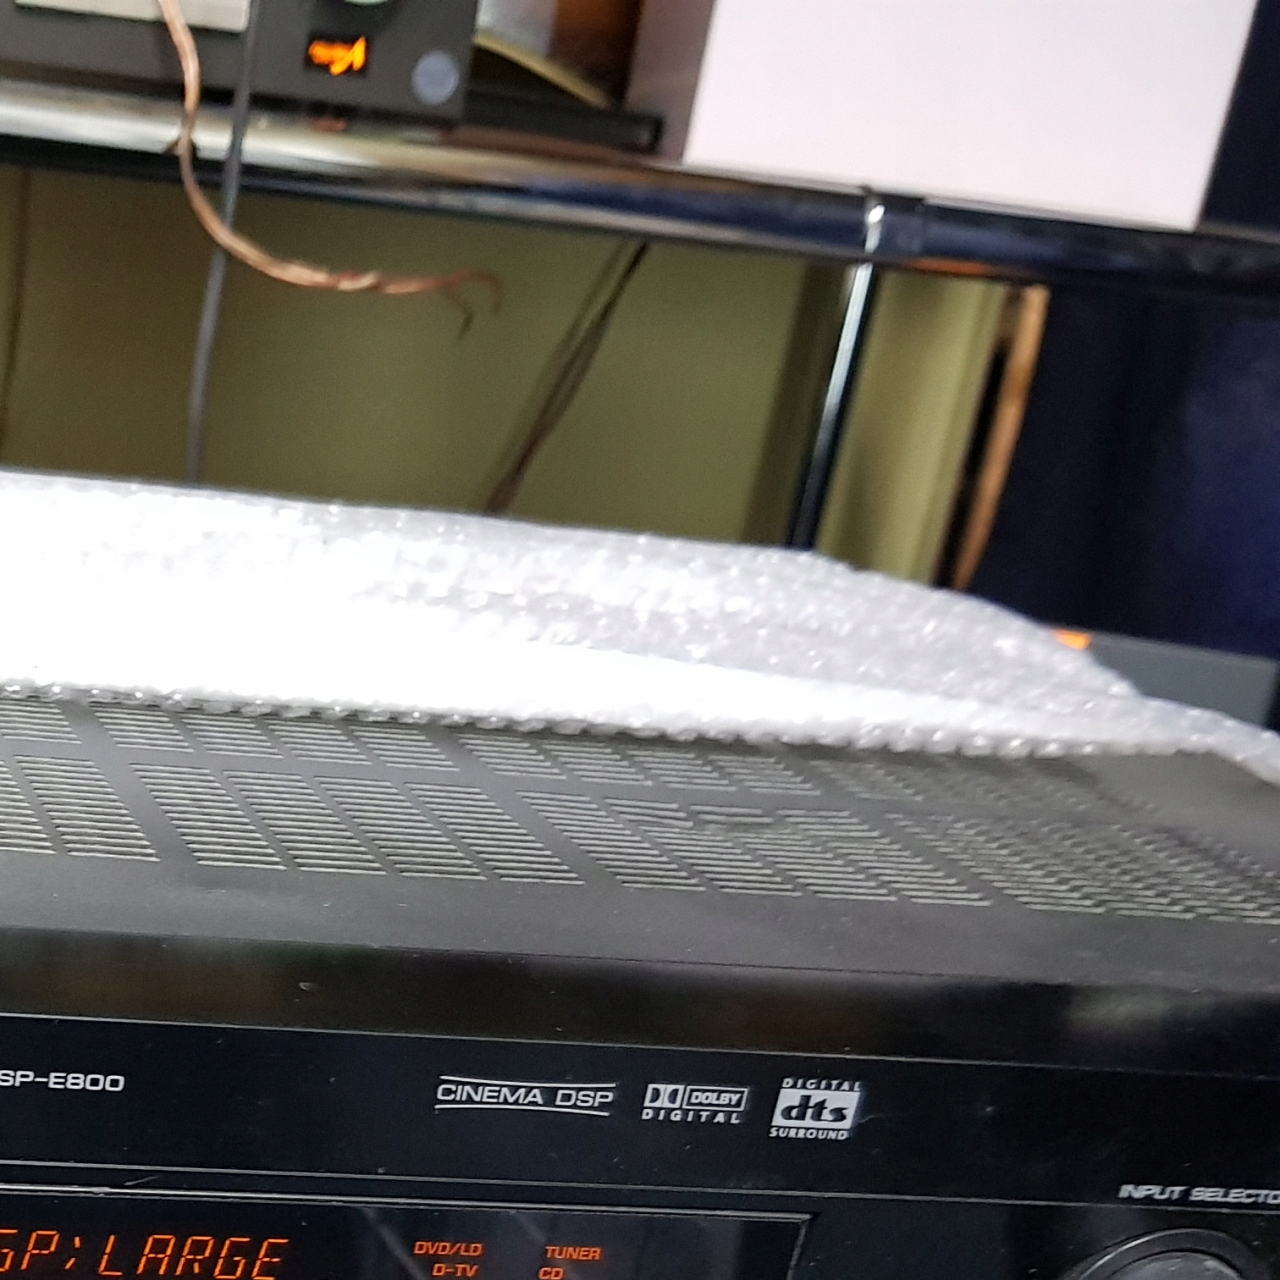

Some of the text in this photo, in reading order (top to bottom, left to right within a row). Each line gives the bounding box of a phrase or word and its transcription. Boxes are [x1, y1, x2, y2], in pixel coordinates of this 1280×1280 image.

[782, 1077, 862, 1093] DIGITAL
[436, 1083, 615, 1109] CINEMA DSP
[690, 1091, 742, 1107] DOLBY
[641, 1108, 741, 1124] DIGITAL
[780, 1094, 850, 1124] dts
[769, 1126, 849, 1141] SURROUND
[1119, 1183, 1189, 1201] INPUT
[413, 1240, 483, 1258] DVD/LD
[545, 1245, 602, 1262] TUNER
[431, 1262, 479, 1278] D-TV
